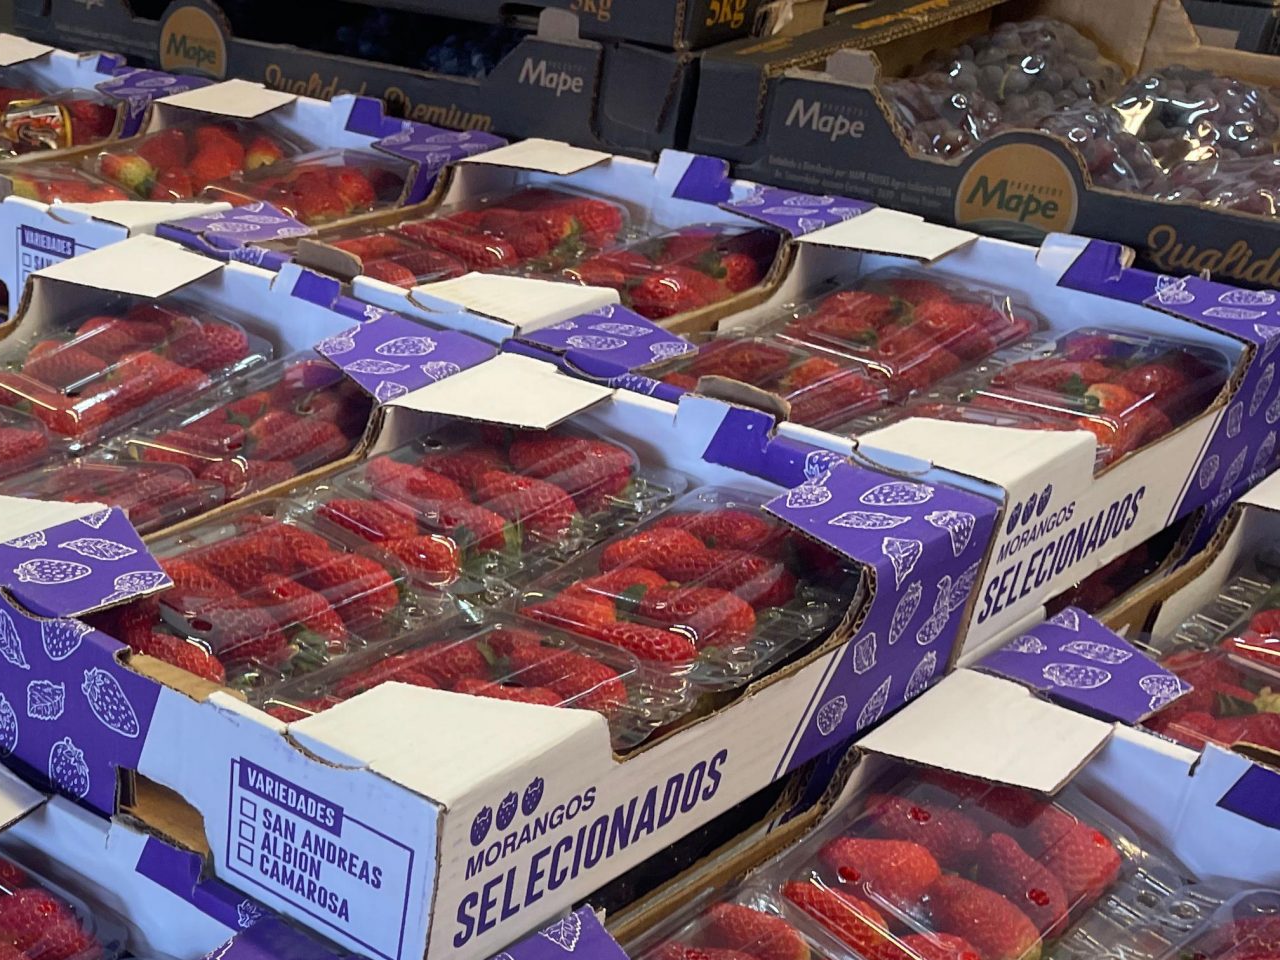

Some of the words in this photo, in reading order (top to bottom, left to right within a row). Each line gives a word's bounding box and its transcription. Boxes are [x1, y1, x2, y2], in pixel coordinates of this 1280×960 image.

[166, 32, 217, 67] Mape
[518, 57, 584, 97] Mape
[785, 98, 865, 142] Mape
[966, 175, 1058, 222] Mape
[977, 485, 1146, 625] SELECIONADOS
[996, 501, 1075, 565] MORANGOS
[247, 767, 335, 827] VARIEDADES
[261, 832, 321, 881] ALBION
[262, 808, 296, 843] SAN
[301, 829, 383, 889] ANDREAS
[453, 748, 728, 948] SELECIONADOS
[465, 786, 597, 881] MORANGOS
[259, 854, 350, 923] CAMAROSA
